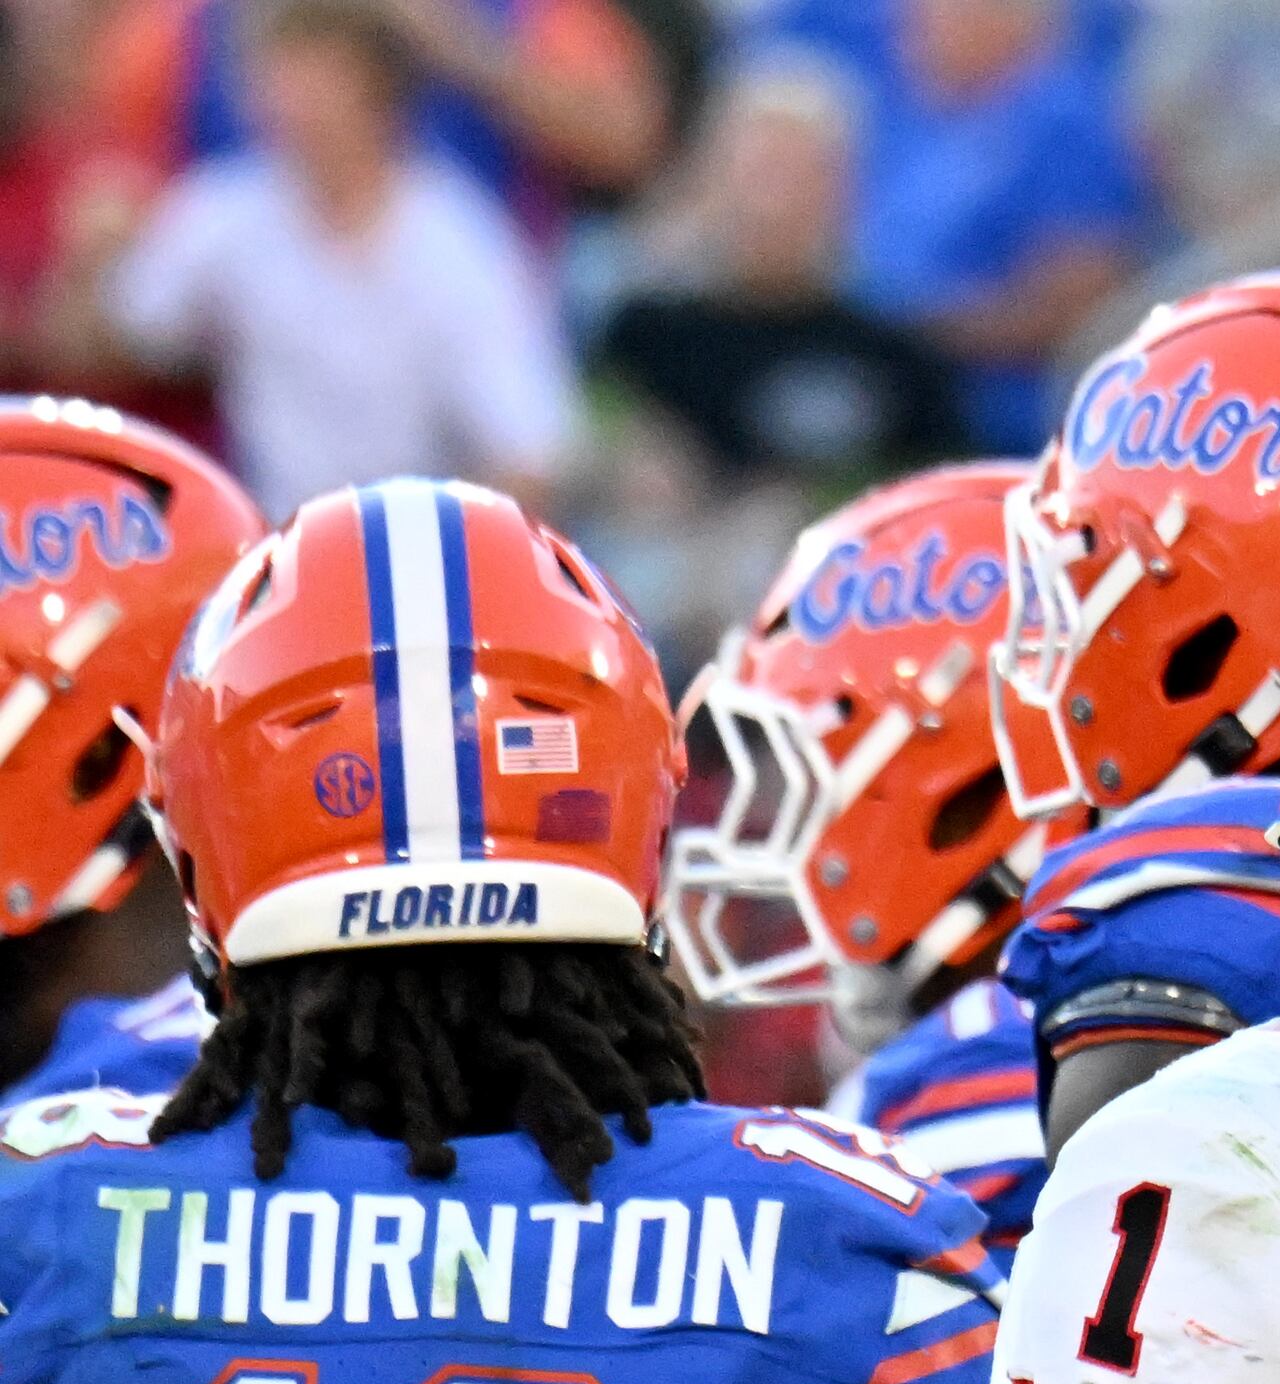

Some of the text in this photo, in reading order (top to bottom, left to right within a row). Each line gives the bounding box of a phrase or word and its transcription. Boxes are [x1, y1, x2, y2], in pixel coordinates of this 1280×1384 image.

[338, 883, 538, 938] FLORIDA
[98, 1186, 783, 1334] THORNTON
[1076, 1181, 1172, 1376] 1
